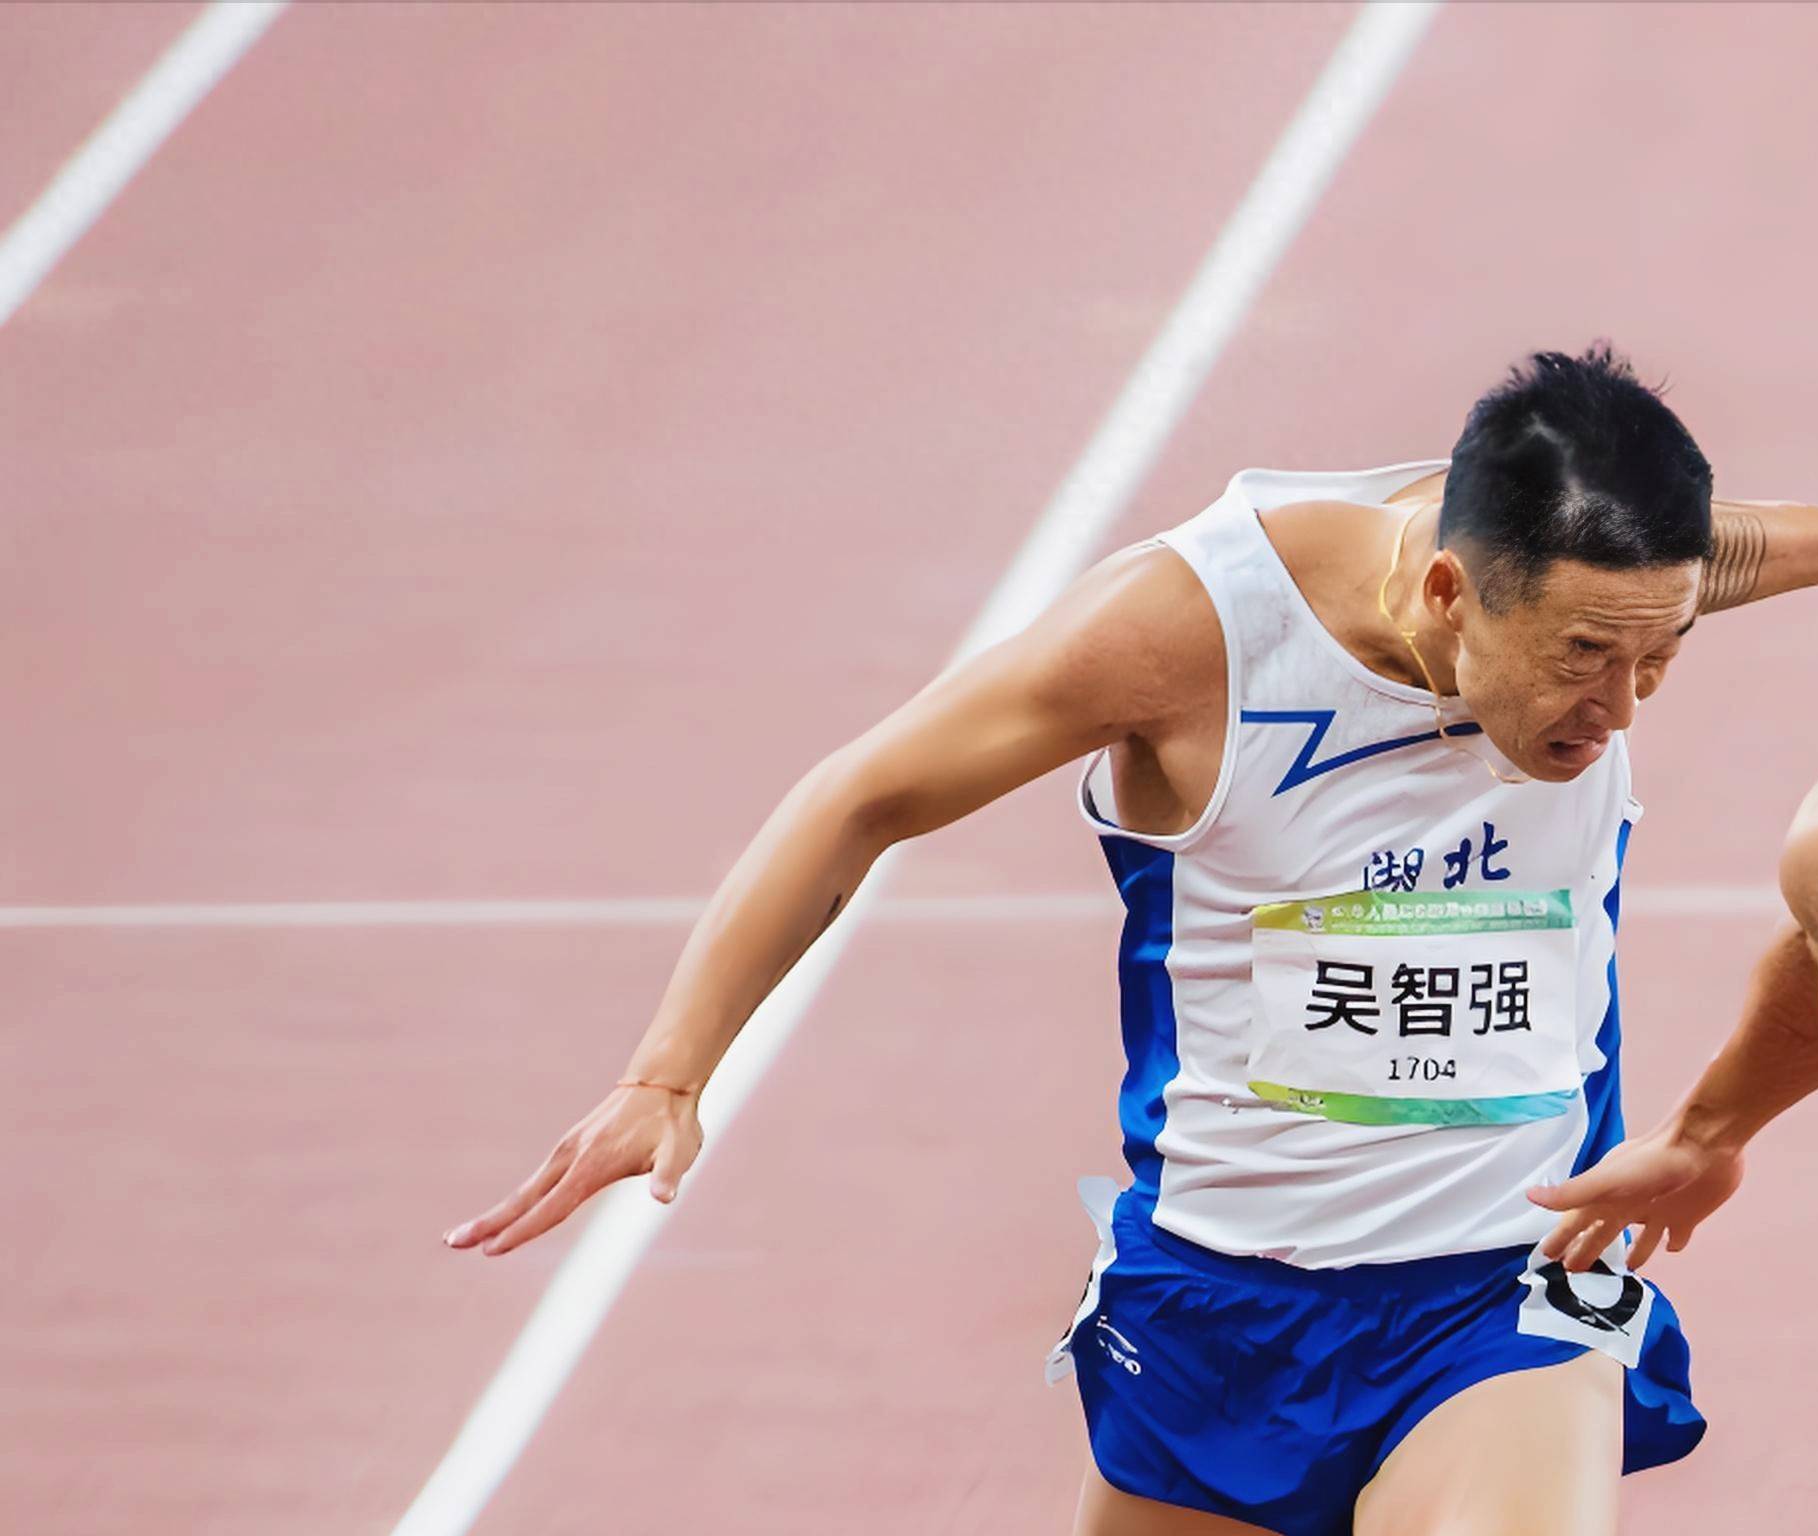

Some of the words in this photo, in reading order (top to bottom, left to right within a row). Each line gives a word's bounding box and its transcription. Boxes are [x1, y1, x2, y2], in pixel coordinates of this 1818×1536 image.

[1364, 821, 1511, 892] 湖北
[1303, 960, 1533, 1038] 吴智强
[1388, 1056, 1457, 1081] 1704
